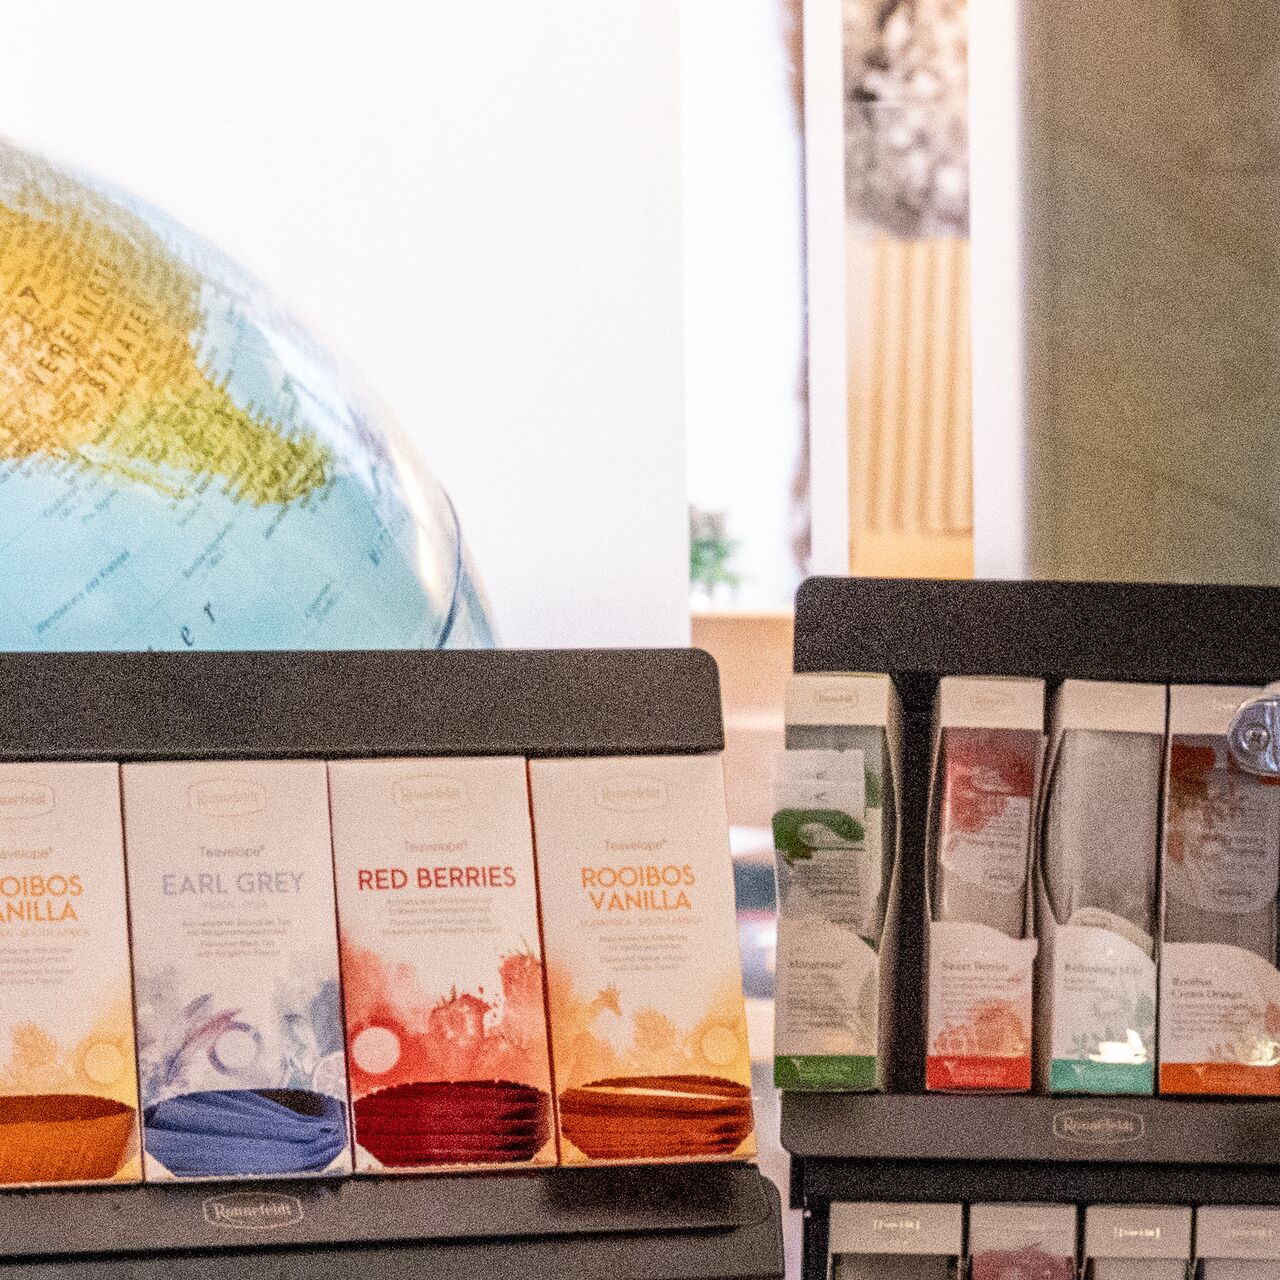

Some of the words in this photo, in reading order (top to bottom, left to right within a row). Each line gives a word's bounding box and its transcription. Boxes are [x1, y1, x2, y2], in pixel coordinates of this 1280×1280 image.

[25, 256, 119, 387] VEREINIGTE
[88, 299, 156, 394] STAATEN
[0, 873, 83, 897] OIBOS
[162, 873, 228, 896] EARL
[236, 871, 304, 894] GREY
[358, 868, 408, 890] RED
[416, 866, 516, 889] BERRIES
[581, 864, 696, 888] ROOIBOS
[0, 899, 78, 922] NILLA
[588, 889, 692, 912] VANILLA
